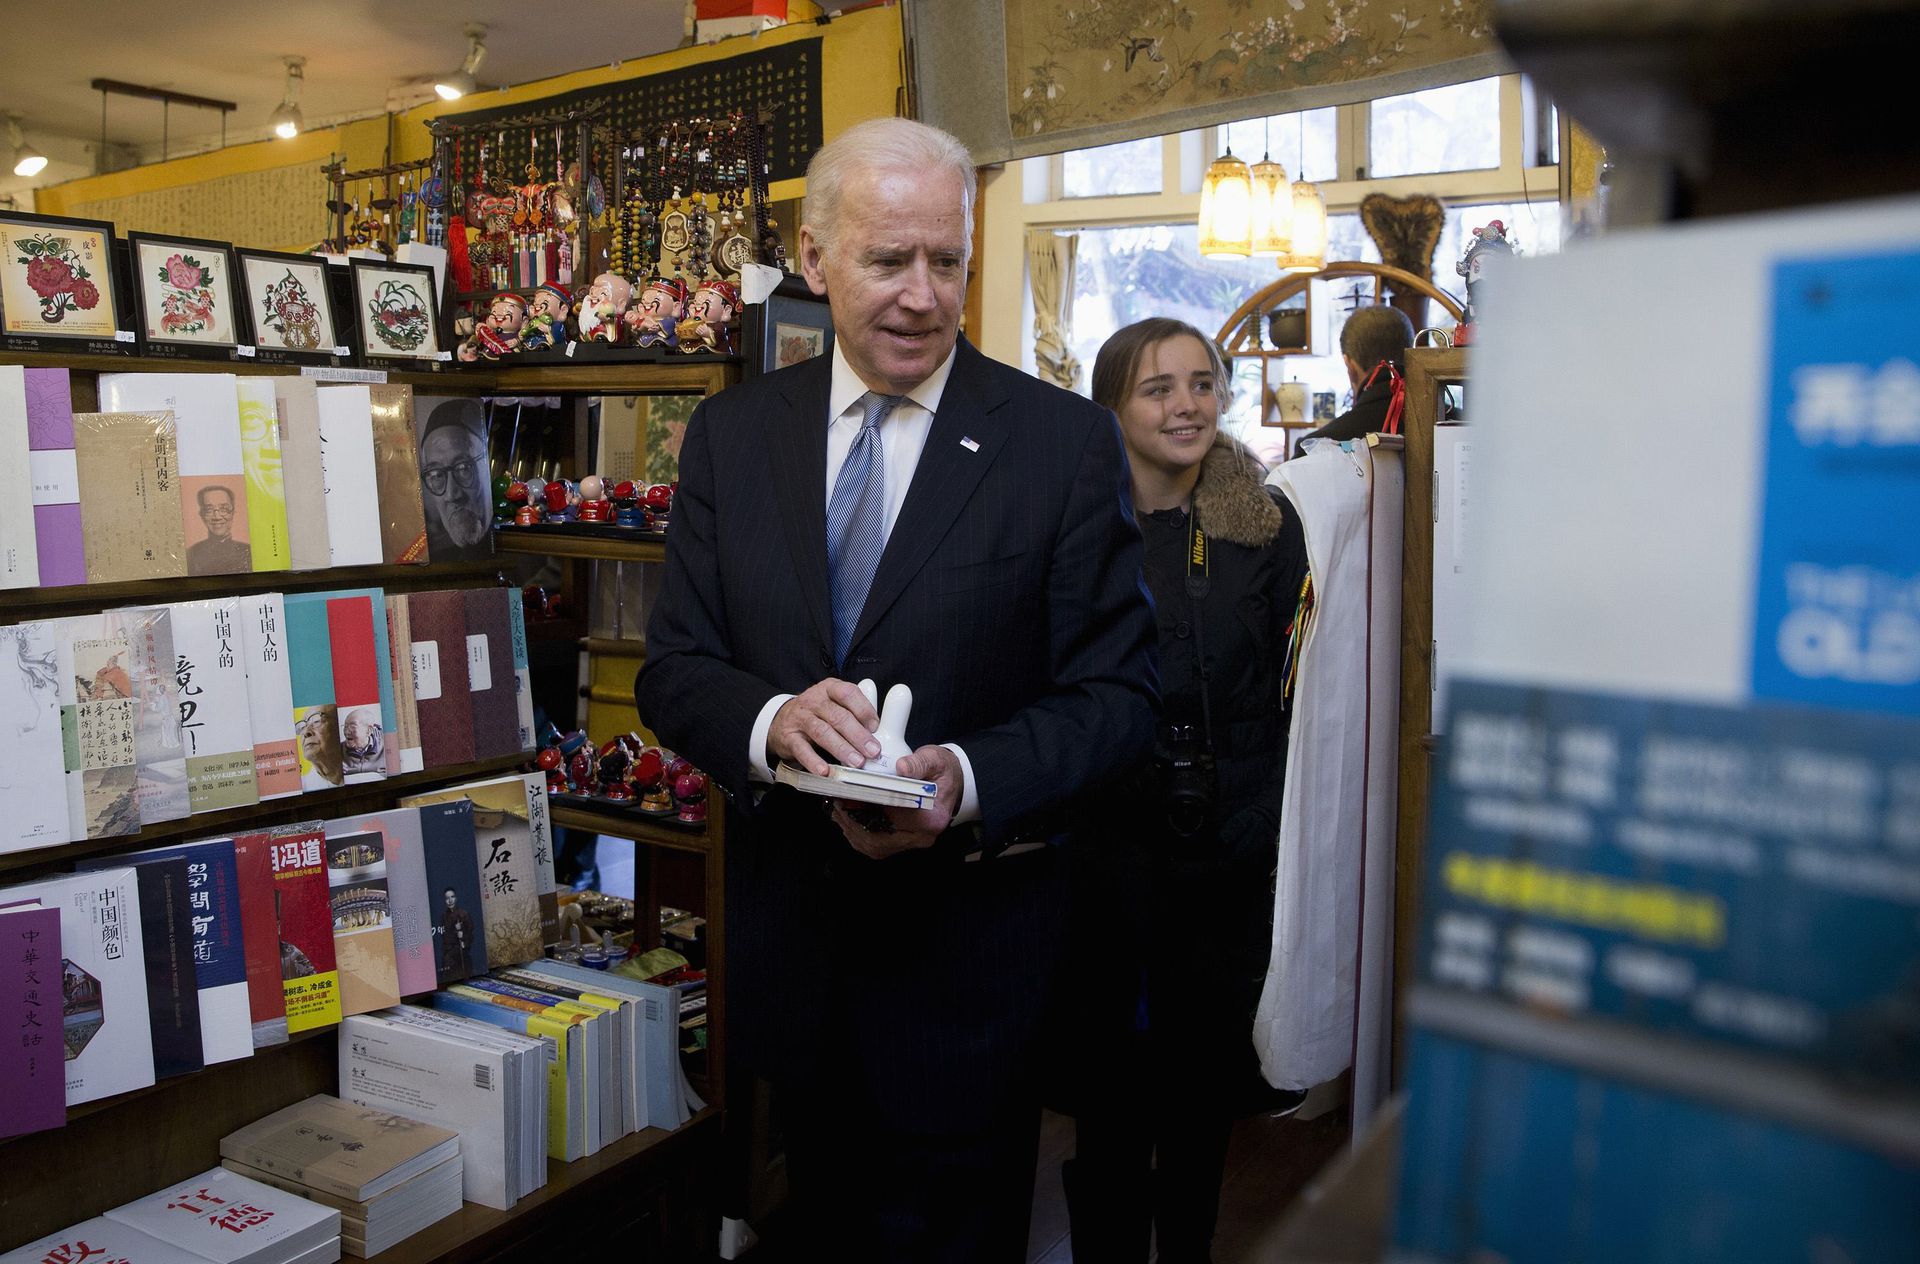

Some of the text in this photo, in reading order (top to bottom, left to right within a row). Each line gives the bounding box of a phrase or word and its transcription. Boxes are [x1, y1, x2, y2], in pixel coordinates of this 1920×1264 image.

[1193, 529, 1204, 565] Nikon
[214, 608, 234, 669] 中国人的
[258, 603, 279, 664] 中国人的
[99, 888, 122, 960] 中国颜色
[21, 929, 43, 1048] 中華交通史話
